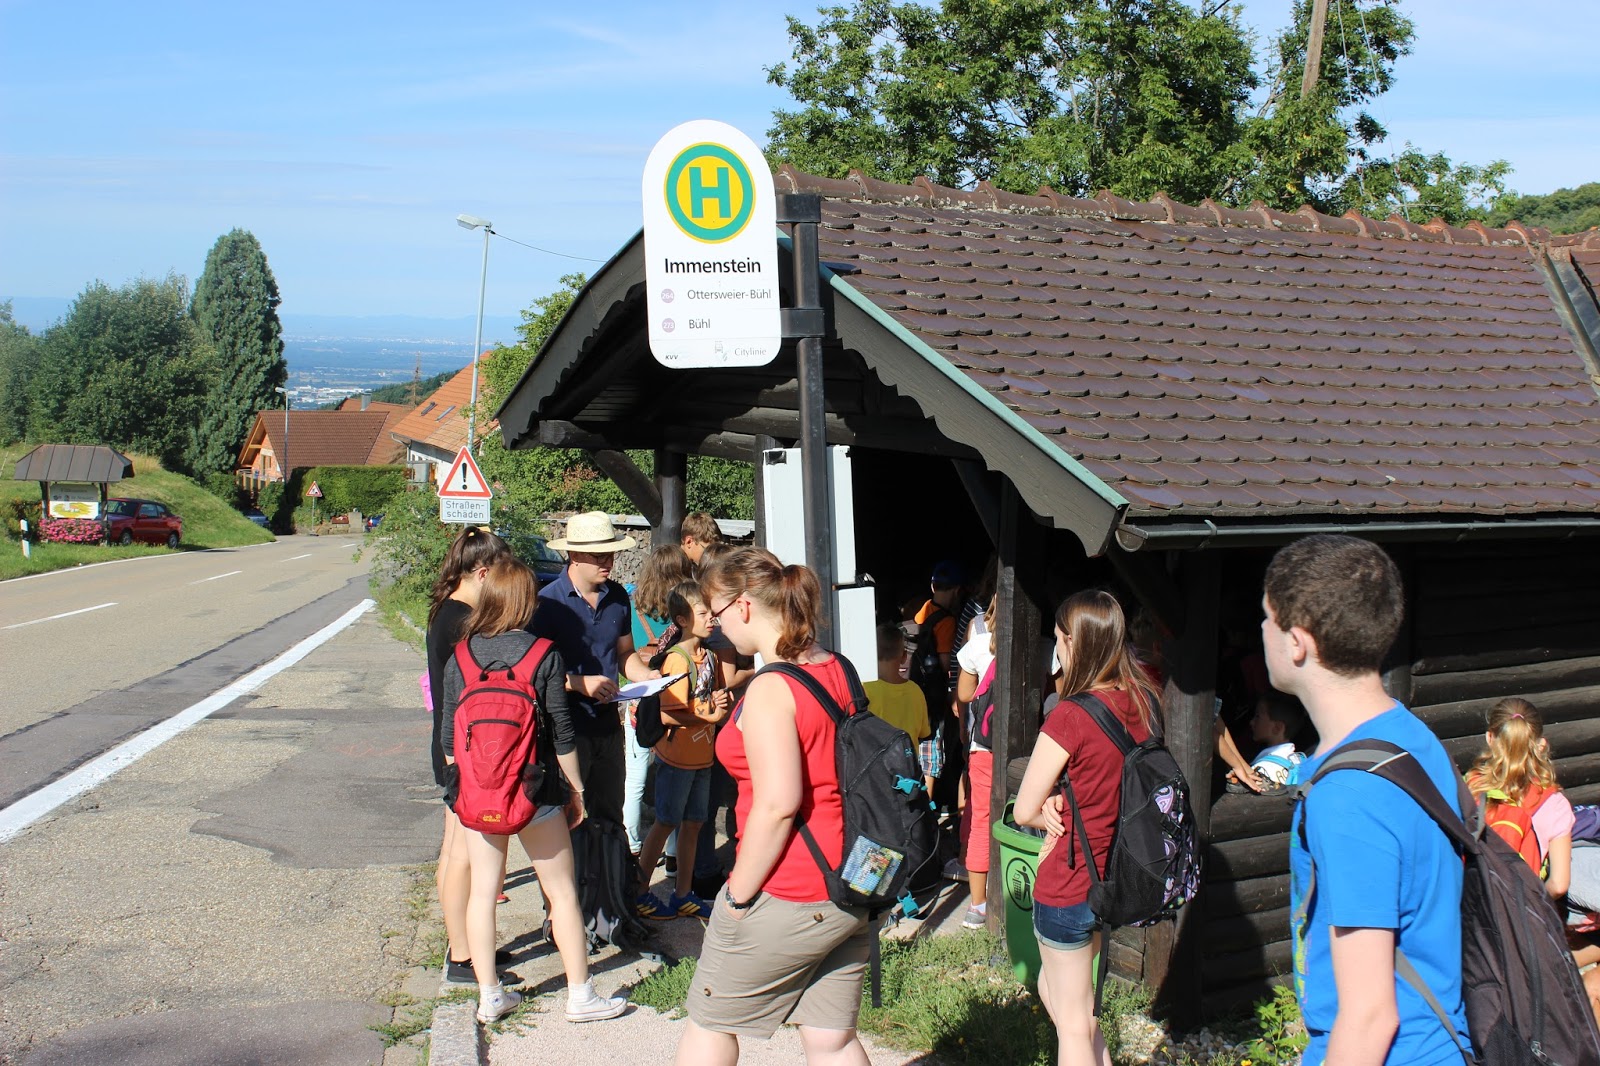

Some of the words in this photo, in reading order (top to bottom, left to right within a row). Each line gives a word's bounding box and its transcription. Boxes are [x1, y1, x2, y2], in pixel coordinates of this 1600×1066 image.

[689, 166, 731, 218] H
[665, 257, 761, 273] Immenstein
[687, 289, 771, 300] Ottersweier-Bühl
[688, 318, 711, 329] Bühl
[734, 347, 767, 357] Citylinie
[445, 501, 485, 510] Straßen-
[446, 510, 484, 518] schäden
